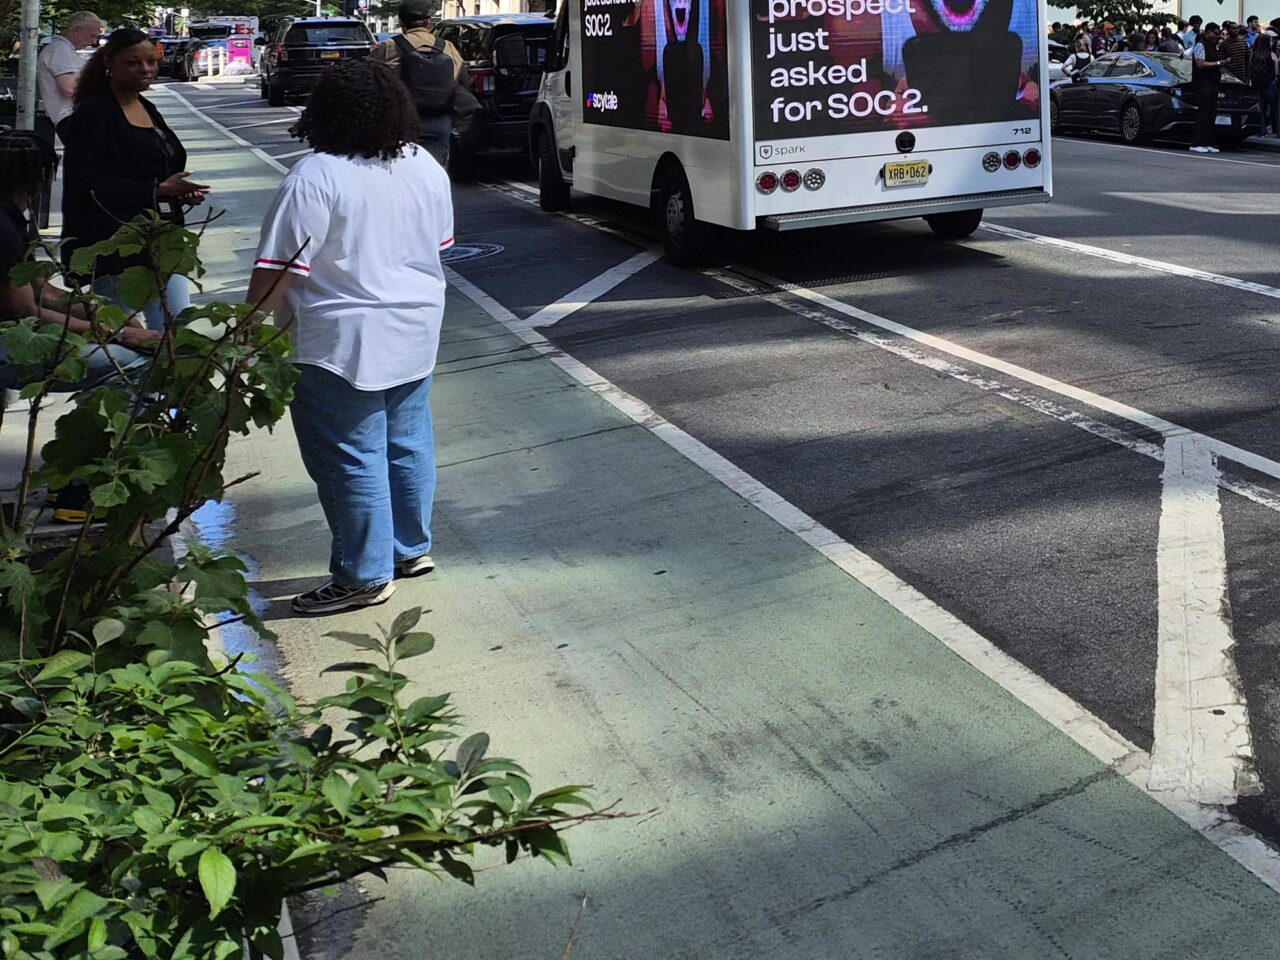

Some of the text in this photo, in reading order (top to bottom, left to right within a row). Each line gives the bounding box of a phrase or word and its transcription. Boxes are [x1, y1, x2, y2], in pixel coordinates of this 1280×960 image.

[585, 14, 603, 37] SOC
[766, 28, 830, 59] just
[770, 58, 867, 88] asked
[592, 91, 618, 112] scytale
[770, 89, 928, 123] for SOC 2.
[1012, 127, 1032, 136] 712
[774, 145, 806, 156] spark
